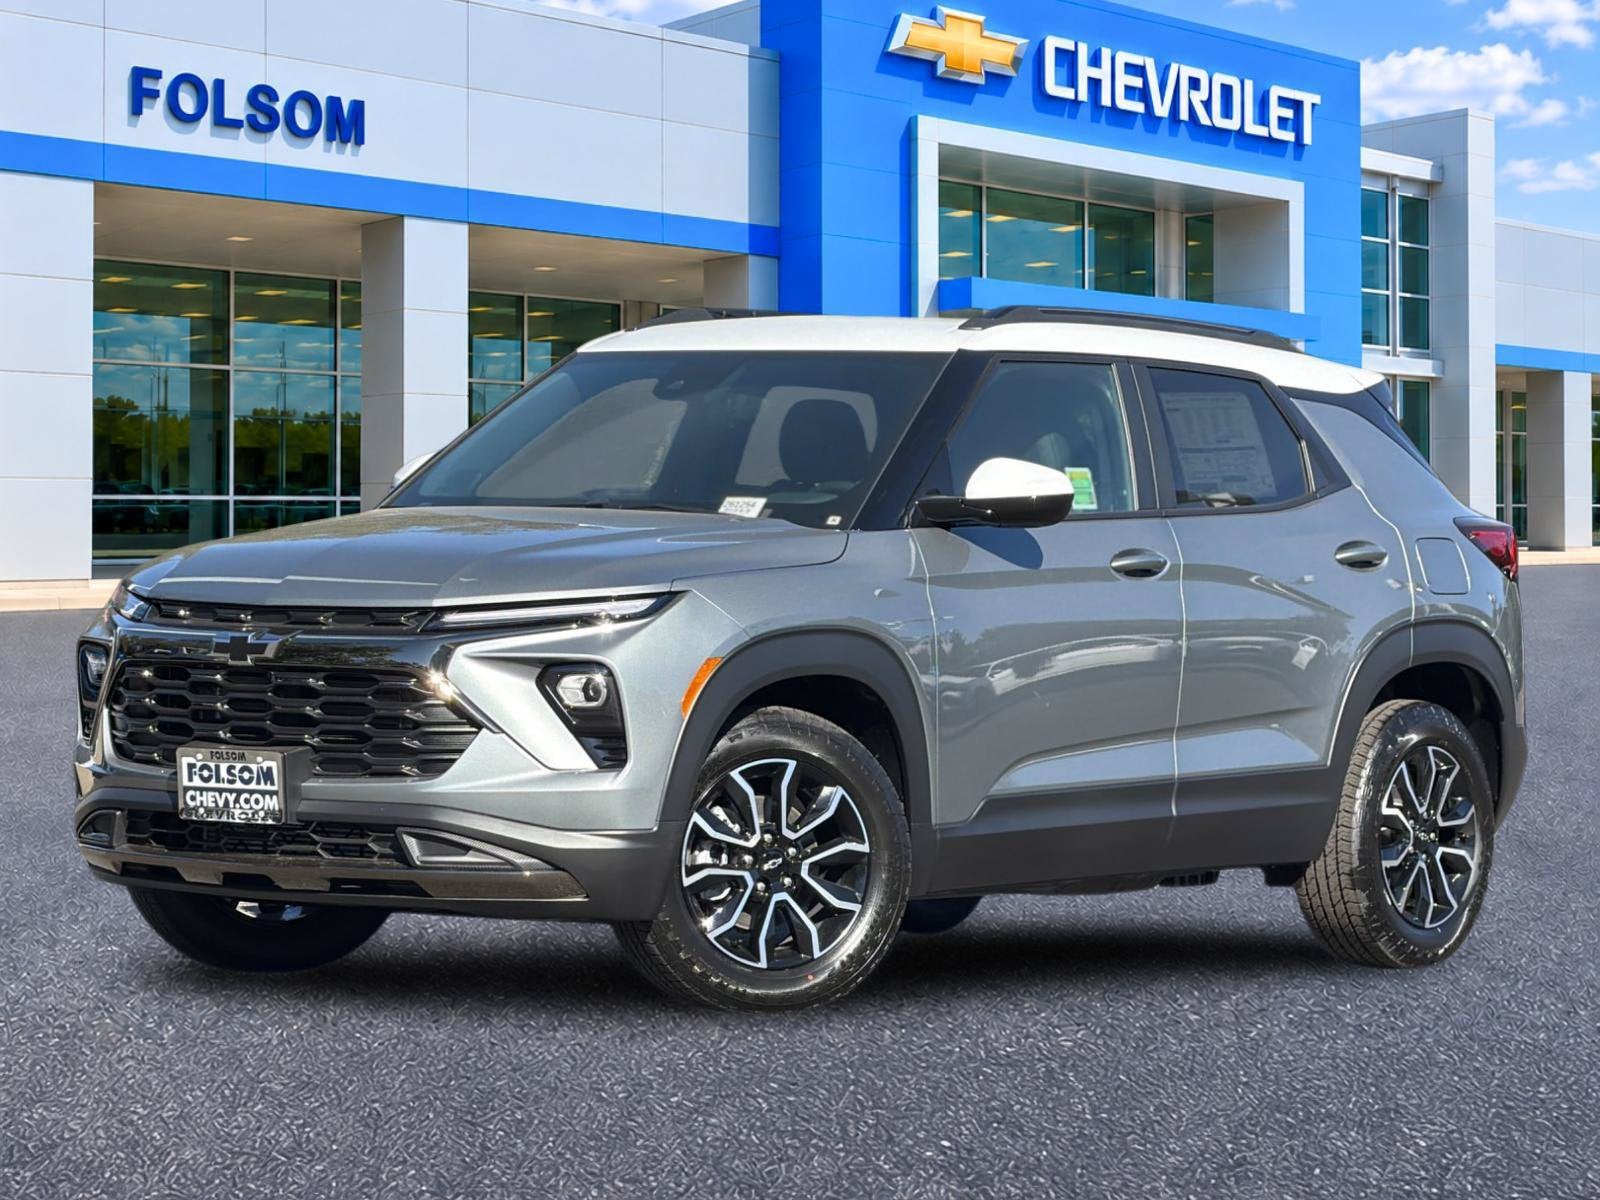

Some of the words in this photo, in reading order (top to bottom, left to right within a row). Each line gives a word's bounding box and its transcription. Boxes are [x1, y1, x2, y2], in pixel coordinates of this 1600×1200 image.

[1044, 35, 1321, 145] CHEVROLET
[131, 65, 365, 146] FOLSOM
[210, 750, 247, 761] FOLSOM
[186, 762, 276, 786] FOLSOM
[185, 789, 279, 811] CHEVY.COM
